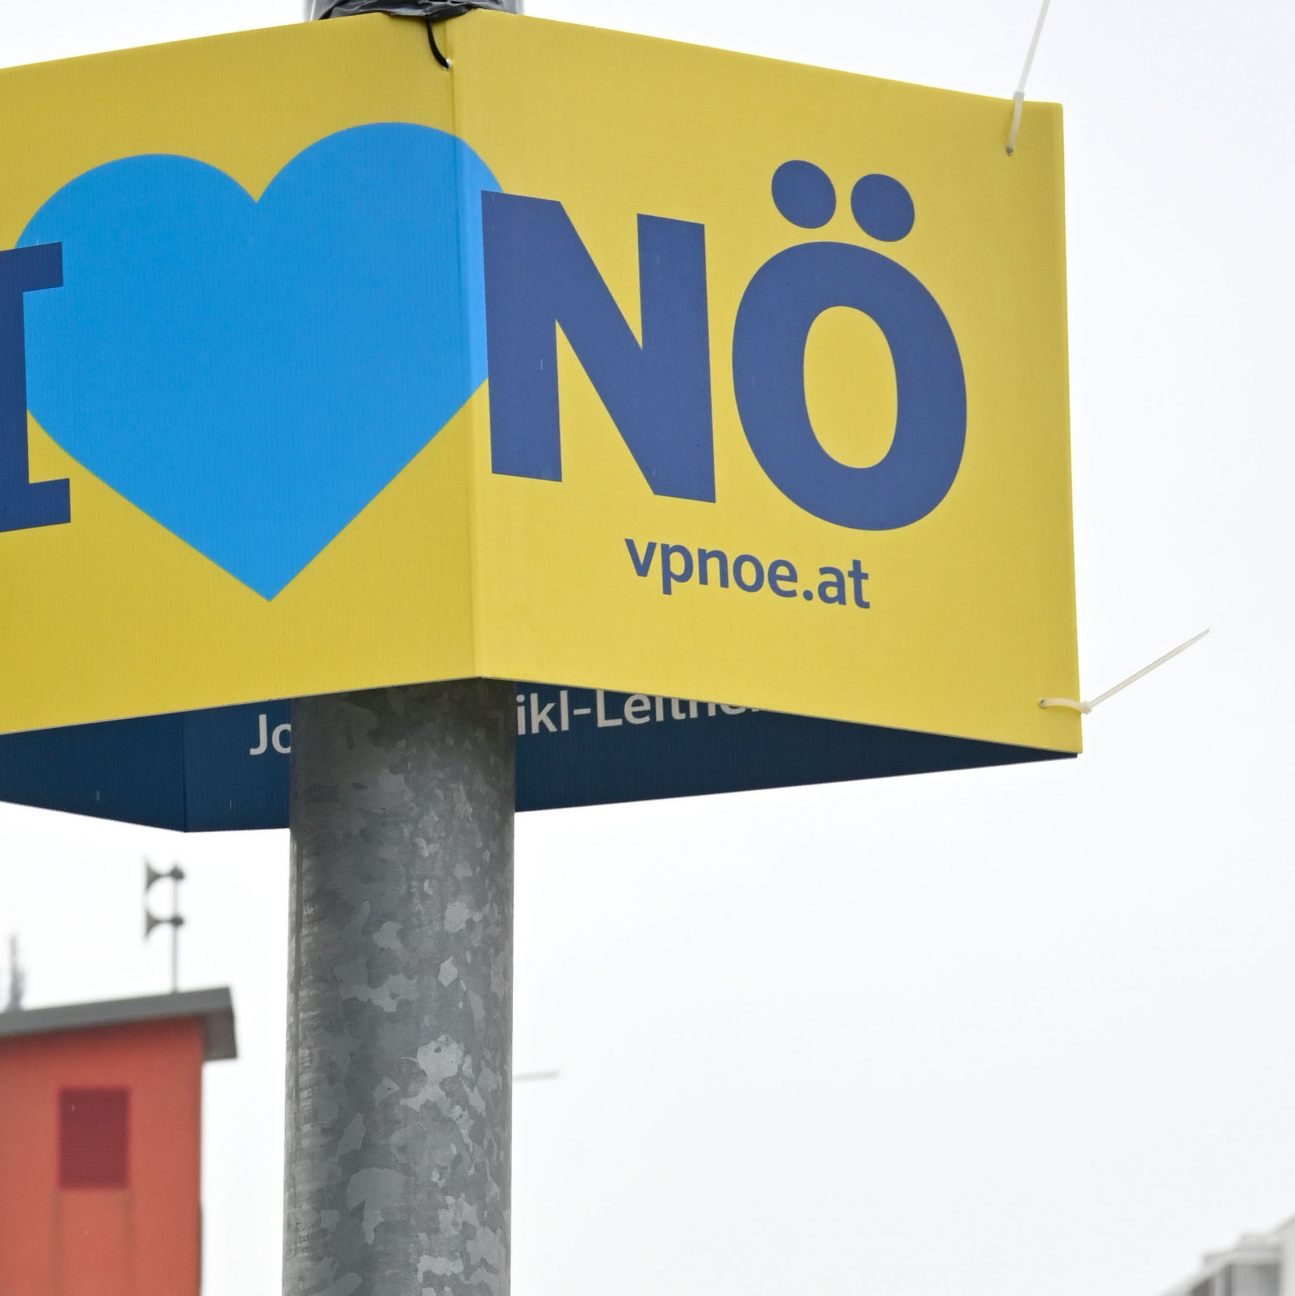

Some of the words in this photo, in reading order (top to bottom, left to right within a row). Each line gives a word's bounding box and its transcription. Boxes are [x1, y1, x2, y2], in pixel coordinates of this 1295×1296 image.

[481, 160, 967, 532] NÖ
[624, 538, 871, 609] vpnoe.at
[516, 689, 768, 736] ikl-Leit
